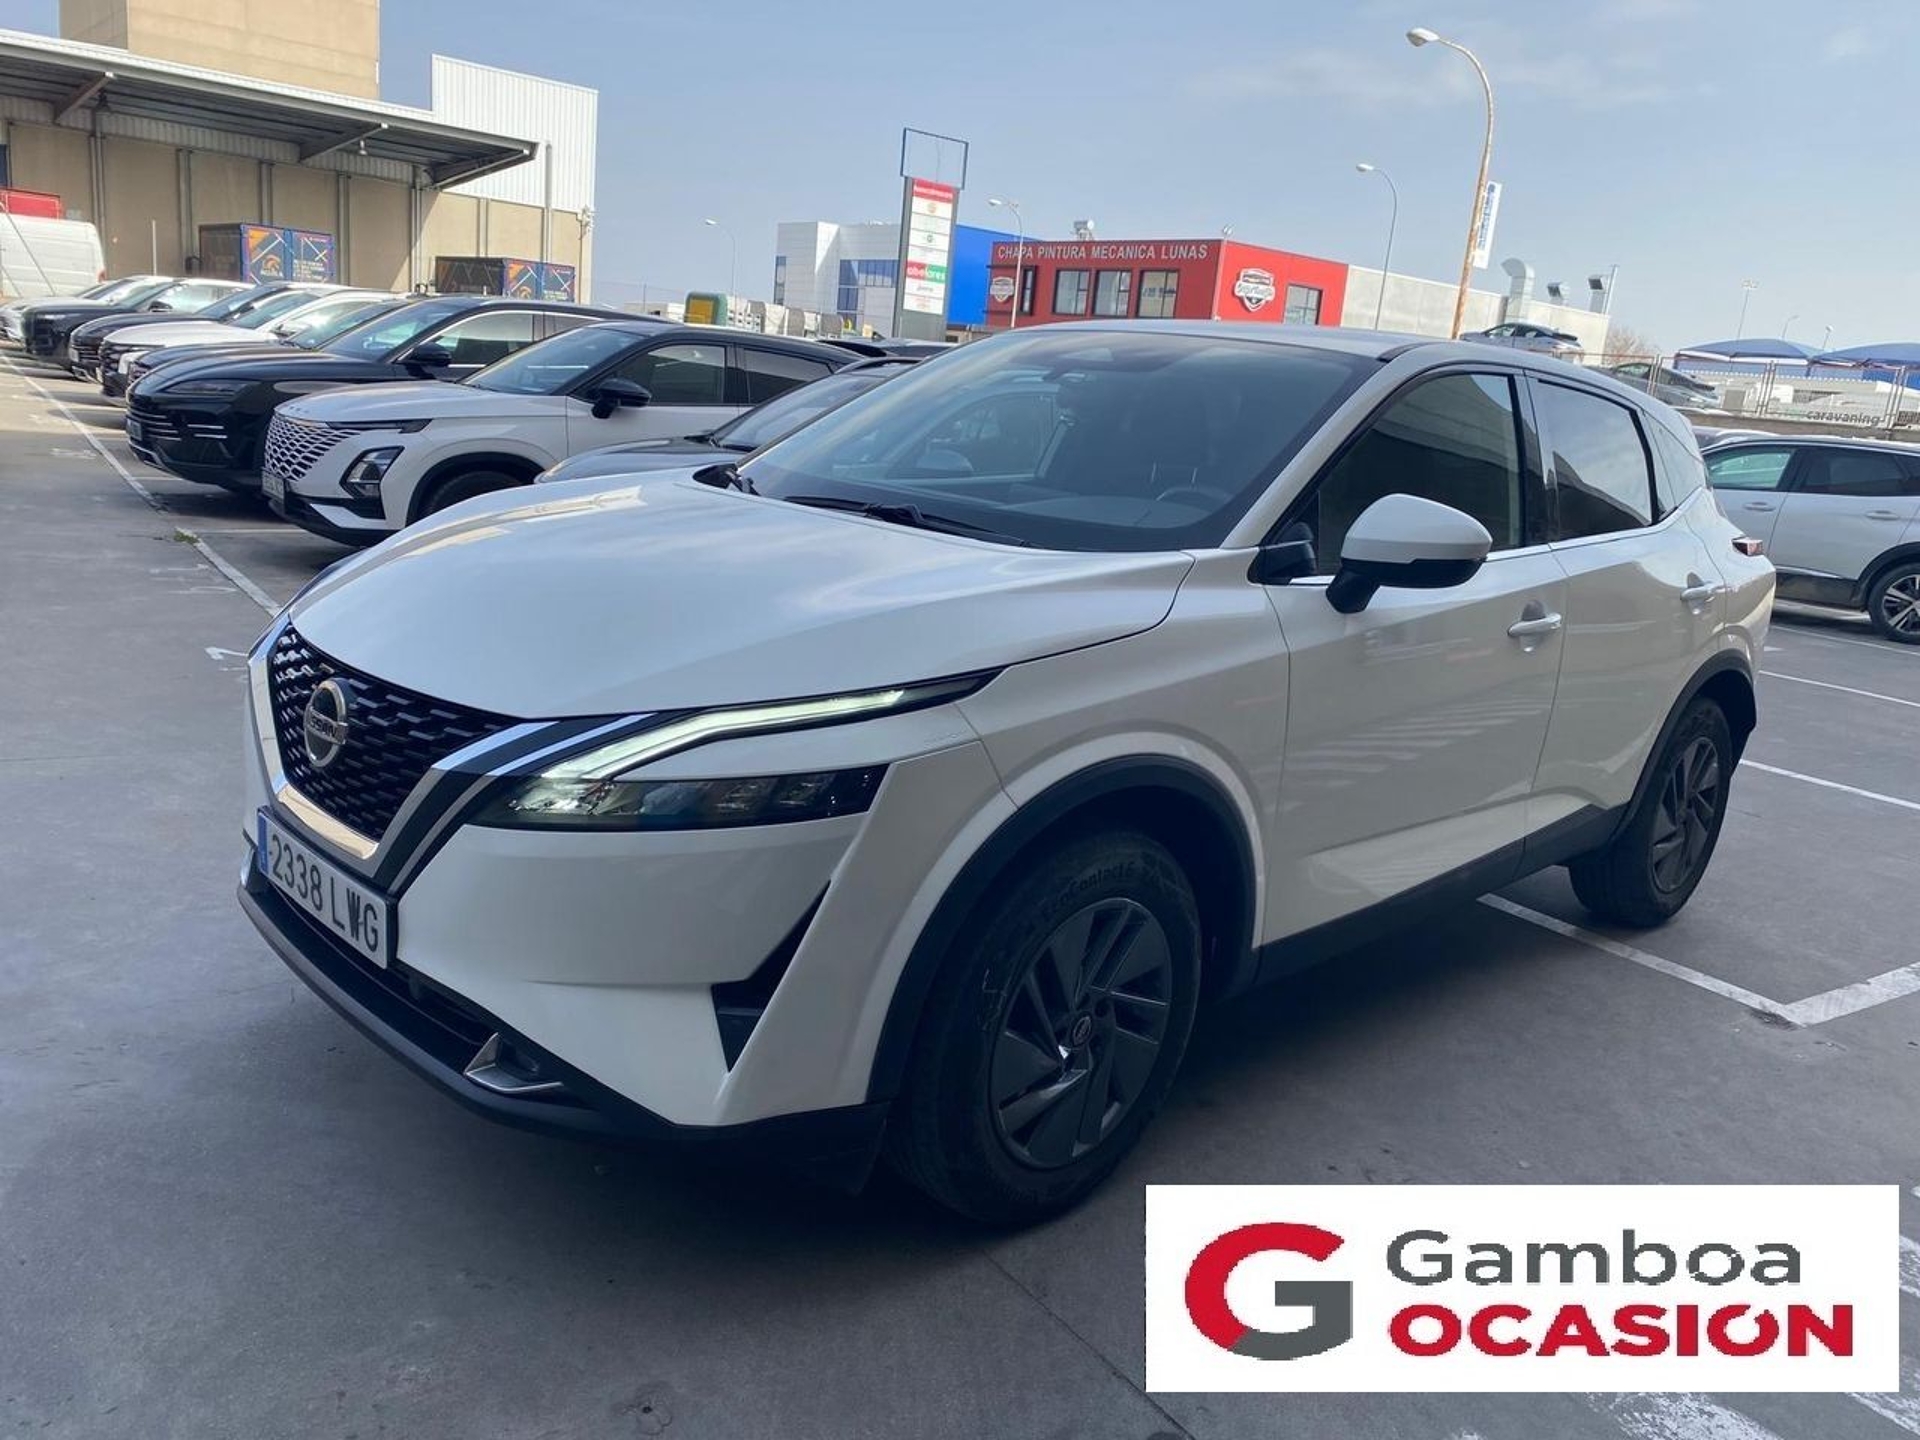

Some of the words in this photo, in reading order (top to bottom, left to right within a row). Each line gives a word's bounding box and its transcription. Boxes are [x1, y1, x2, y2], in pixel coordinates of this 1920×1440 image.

[997, 246, 1033, 260] CHAPA
[1037, 246, 1086, 259] PINTURA
[1091, 245, 1156, 259] MECANICA
[1161, 244, 1208, 259] LUNAS
[1807, 411, 1880, 427] caravaning
[271, 834, 323, 913] 2338
[331, 876, 378, 953] LWG
